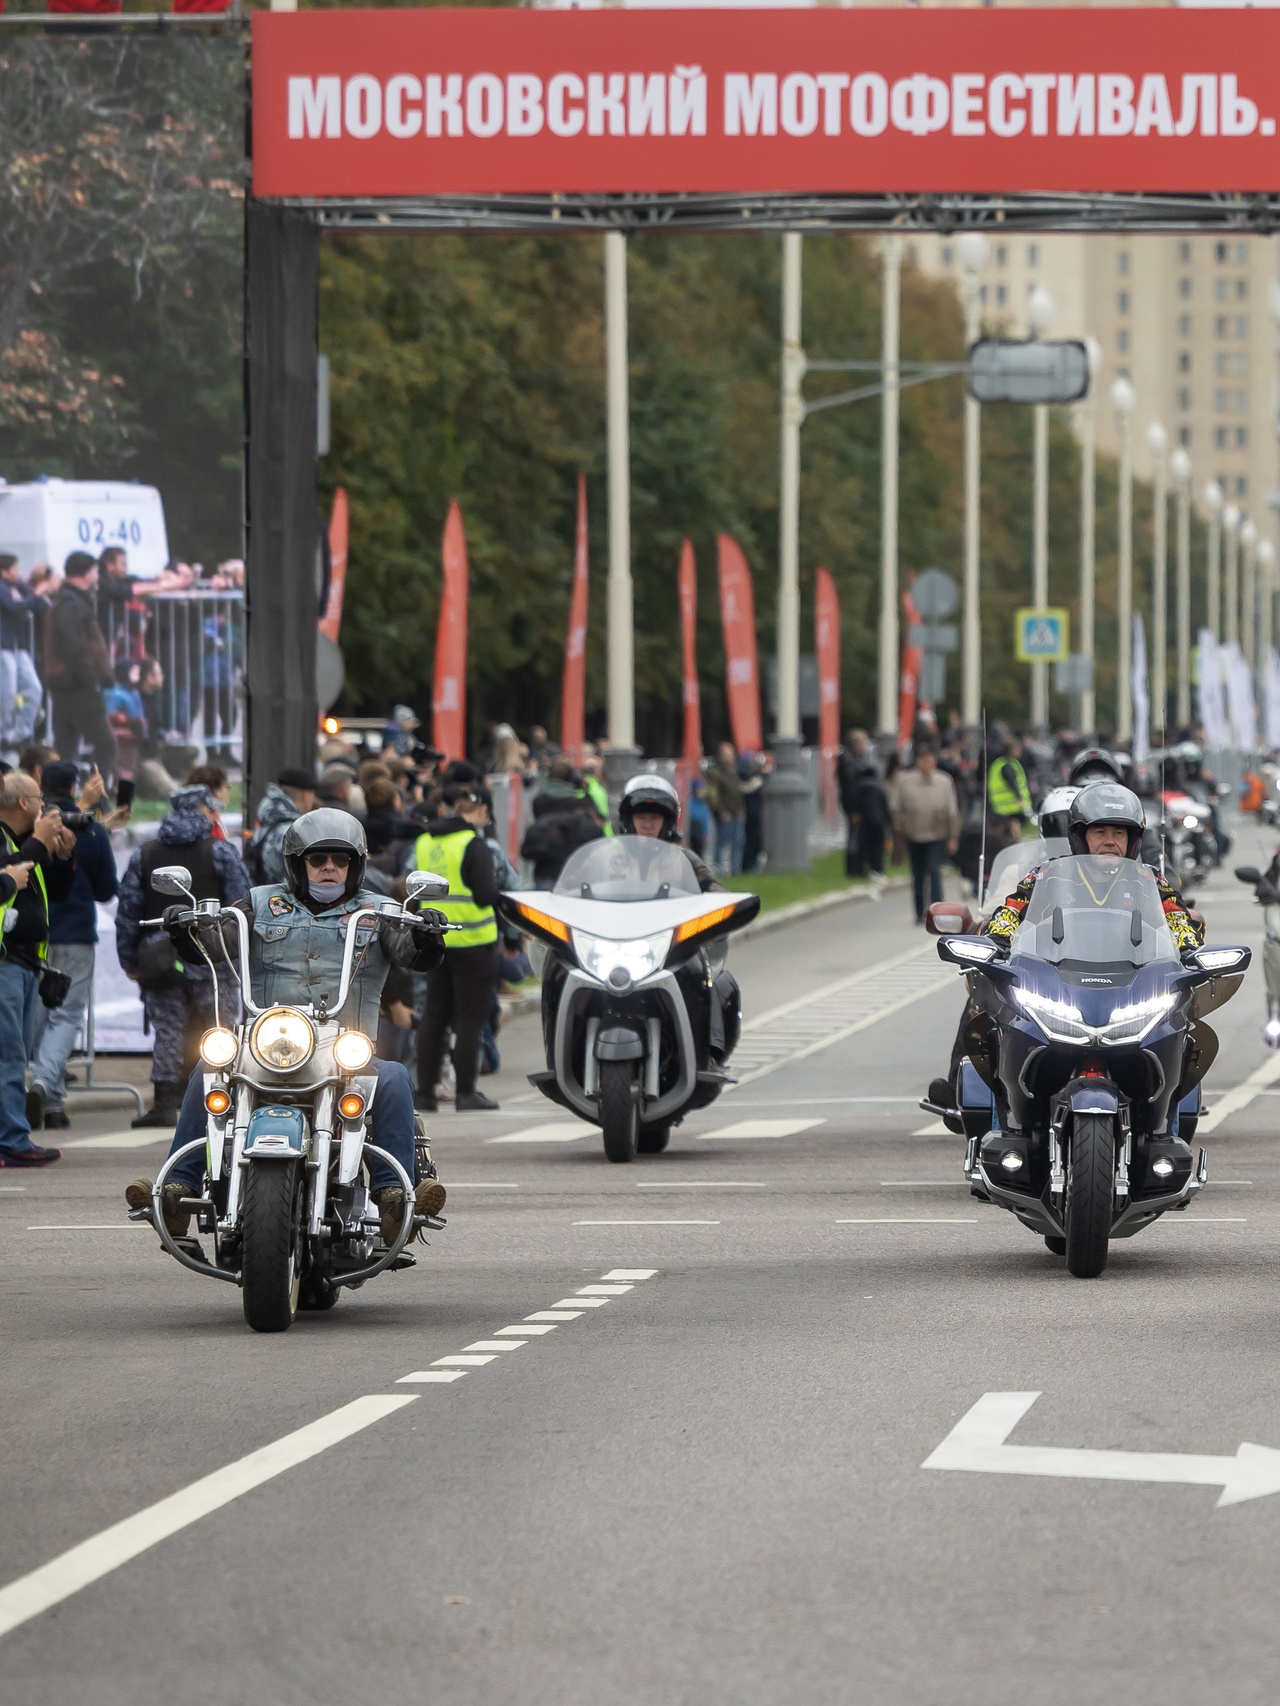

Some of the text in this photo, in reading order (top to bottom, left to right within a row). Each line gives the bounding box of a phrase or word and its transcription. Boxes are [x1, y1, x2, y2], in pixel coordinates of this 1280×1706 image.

[287, 65, 708, 139] МОСКОВСКИЙ
[723, 72, 1276, 138] МОТОФЕСТИВАЛЬ.
[78, 518, 142, 544] 02-40
